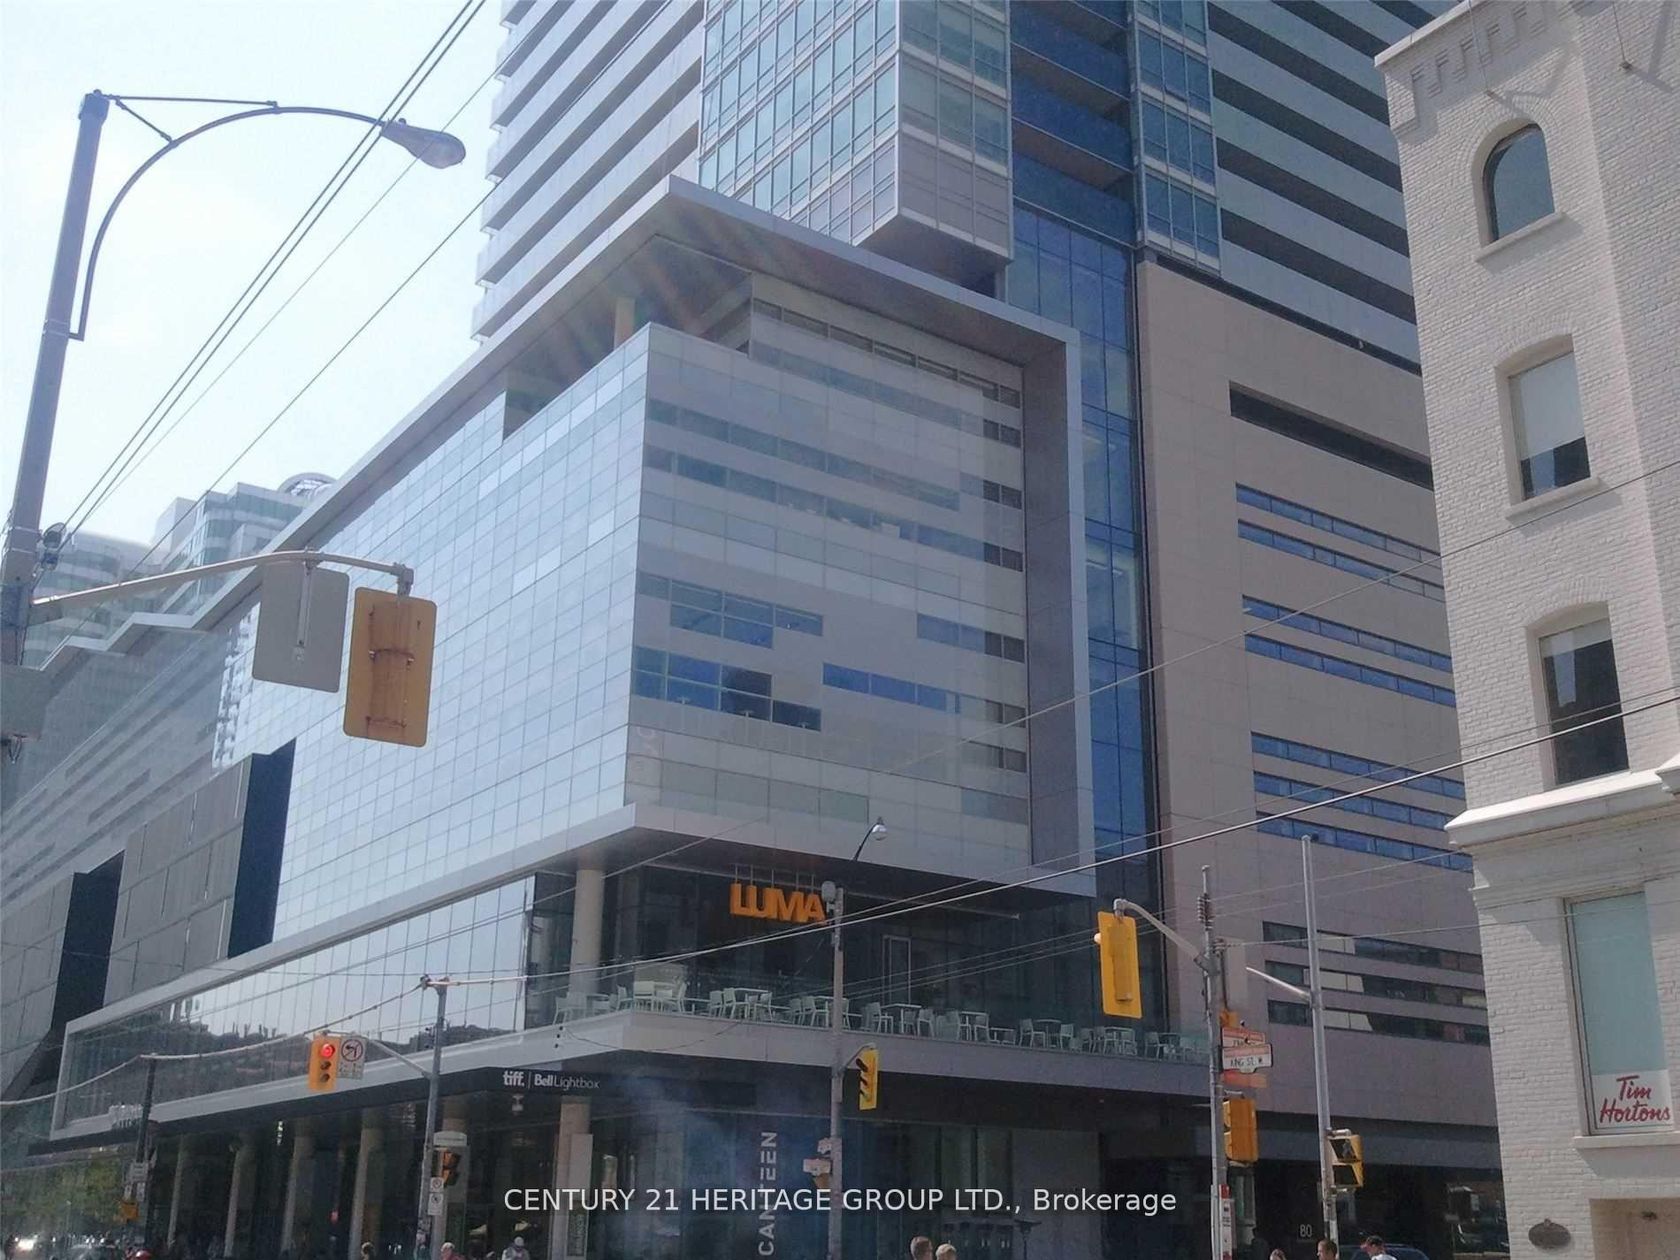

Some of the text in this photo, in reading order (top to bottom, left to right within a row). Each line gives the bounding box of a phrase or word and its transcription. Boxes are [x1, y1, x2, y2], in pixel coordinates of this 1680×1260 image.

[730, 883, 826, 924] LUMA
[503, 1070, 525, 1087] tiff.
[1616, 1075, 1652, 1101] Tim
[1600, 1098, 1670, 1123] Hortons
